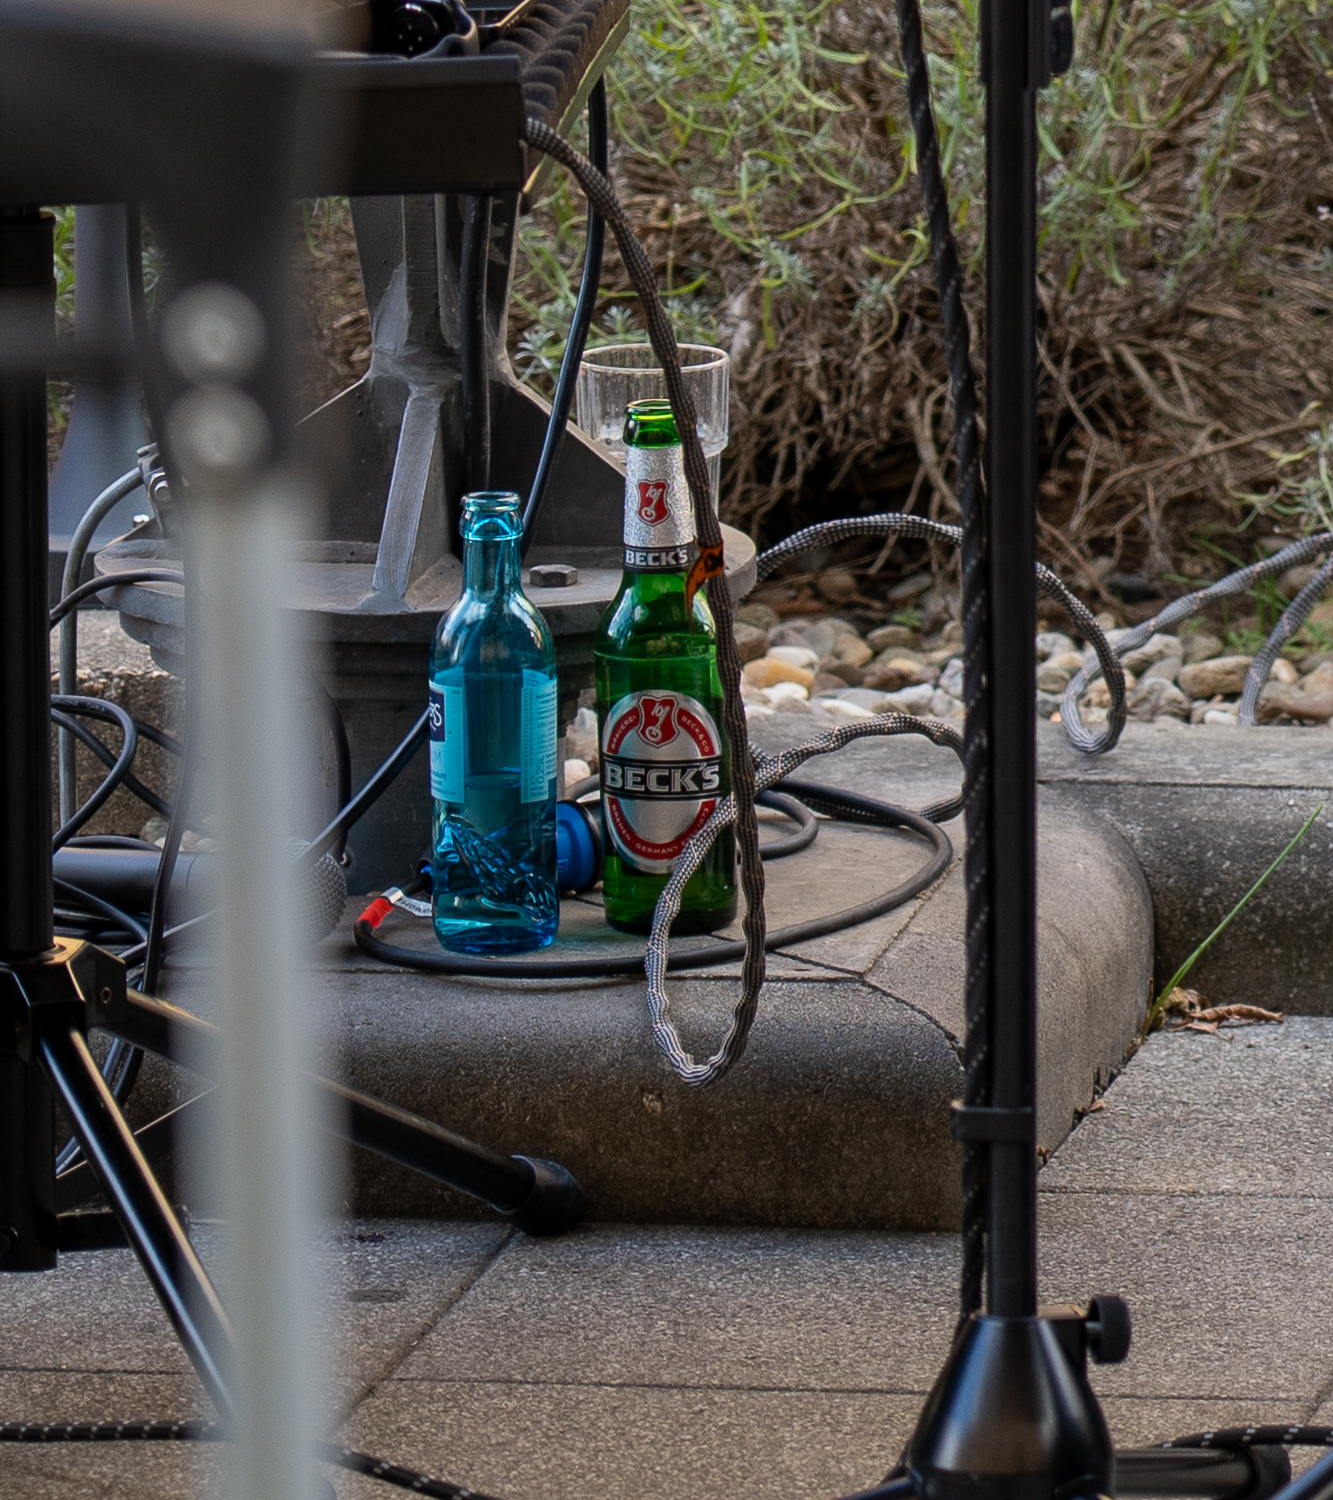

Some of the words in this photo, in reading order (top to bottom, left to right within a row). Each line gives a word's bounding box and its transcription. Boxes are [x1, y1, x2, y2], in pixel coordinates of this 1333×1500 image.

[625, 548, 688, 566] BECK'S
[604, 761, 720, 792] BECK'S
[635, 841, 680, 855] GERMANY
